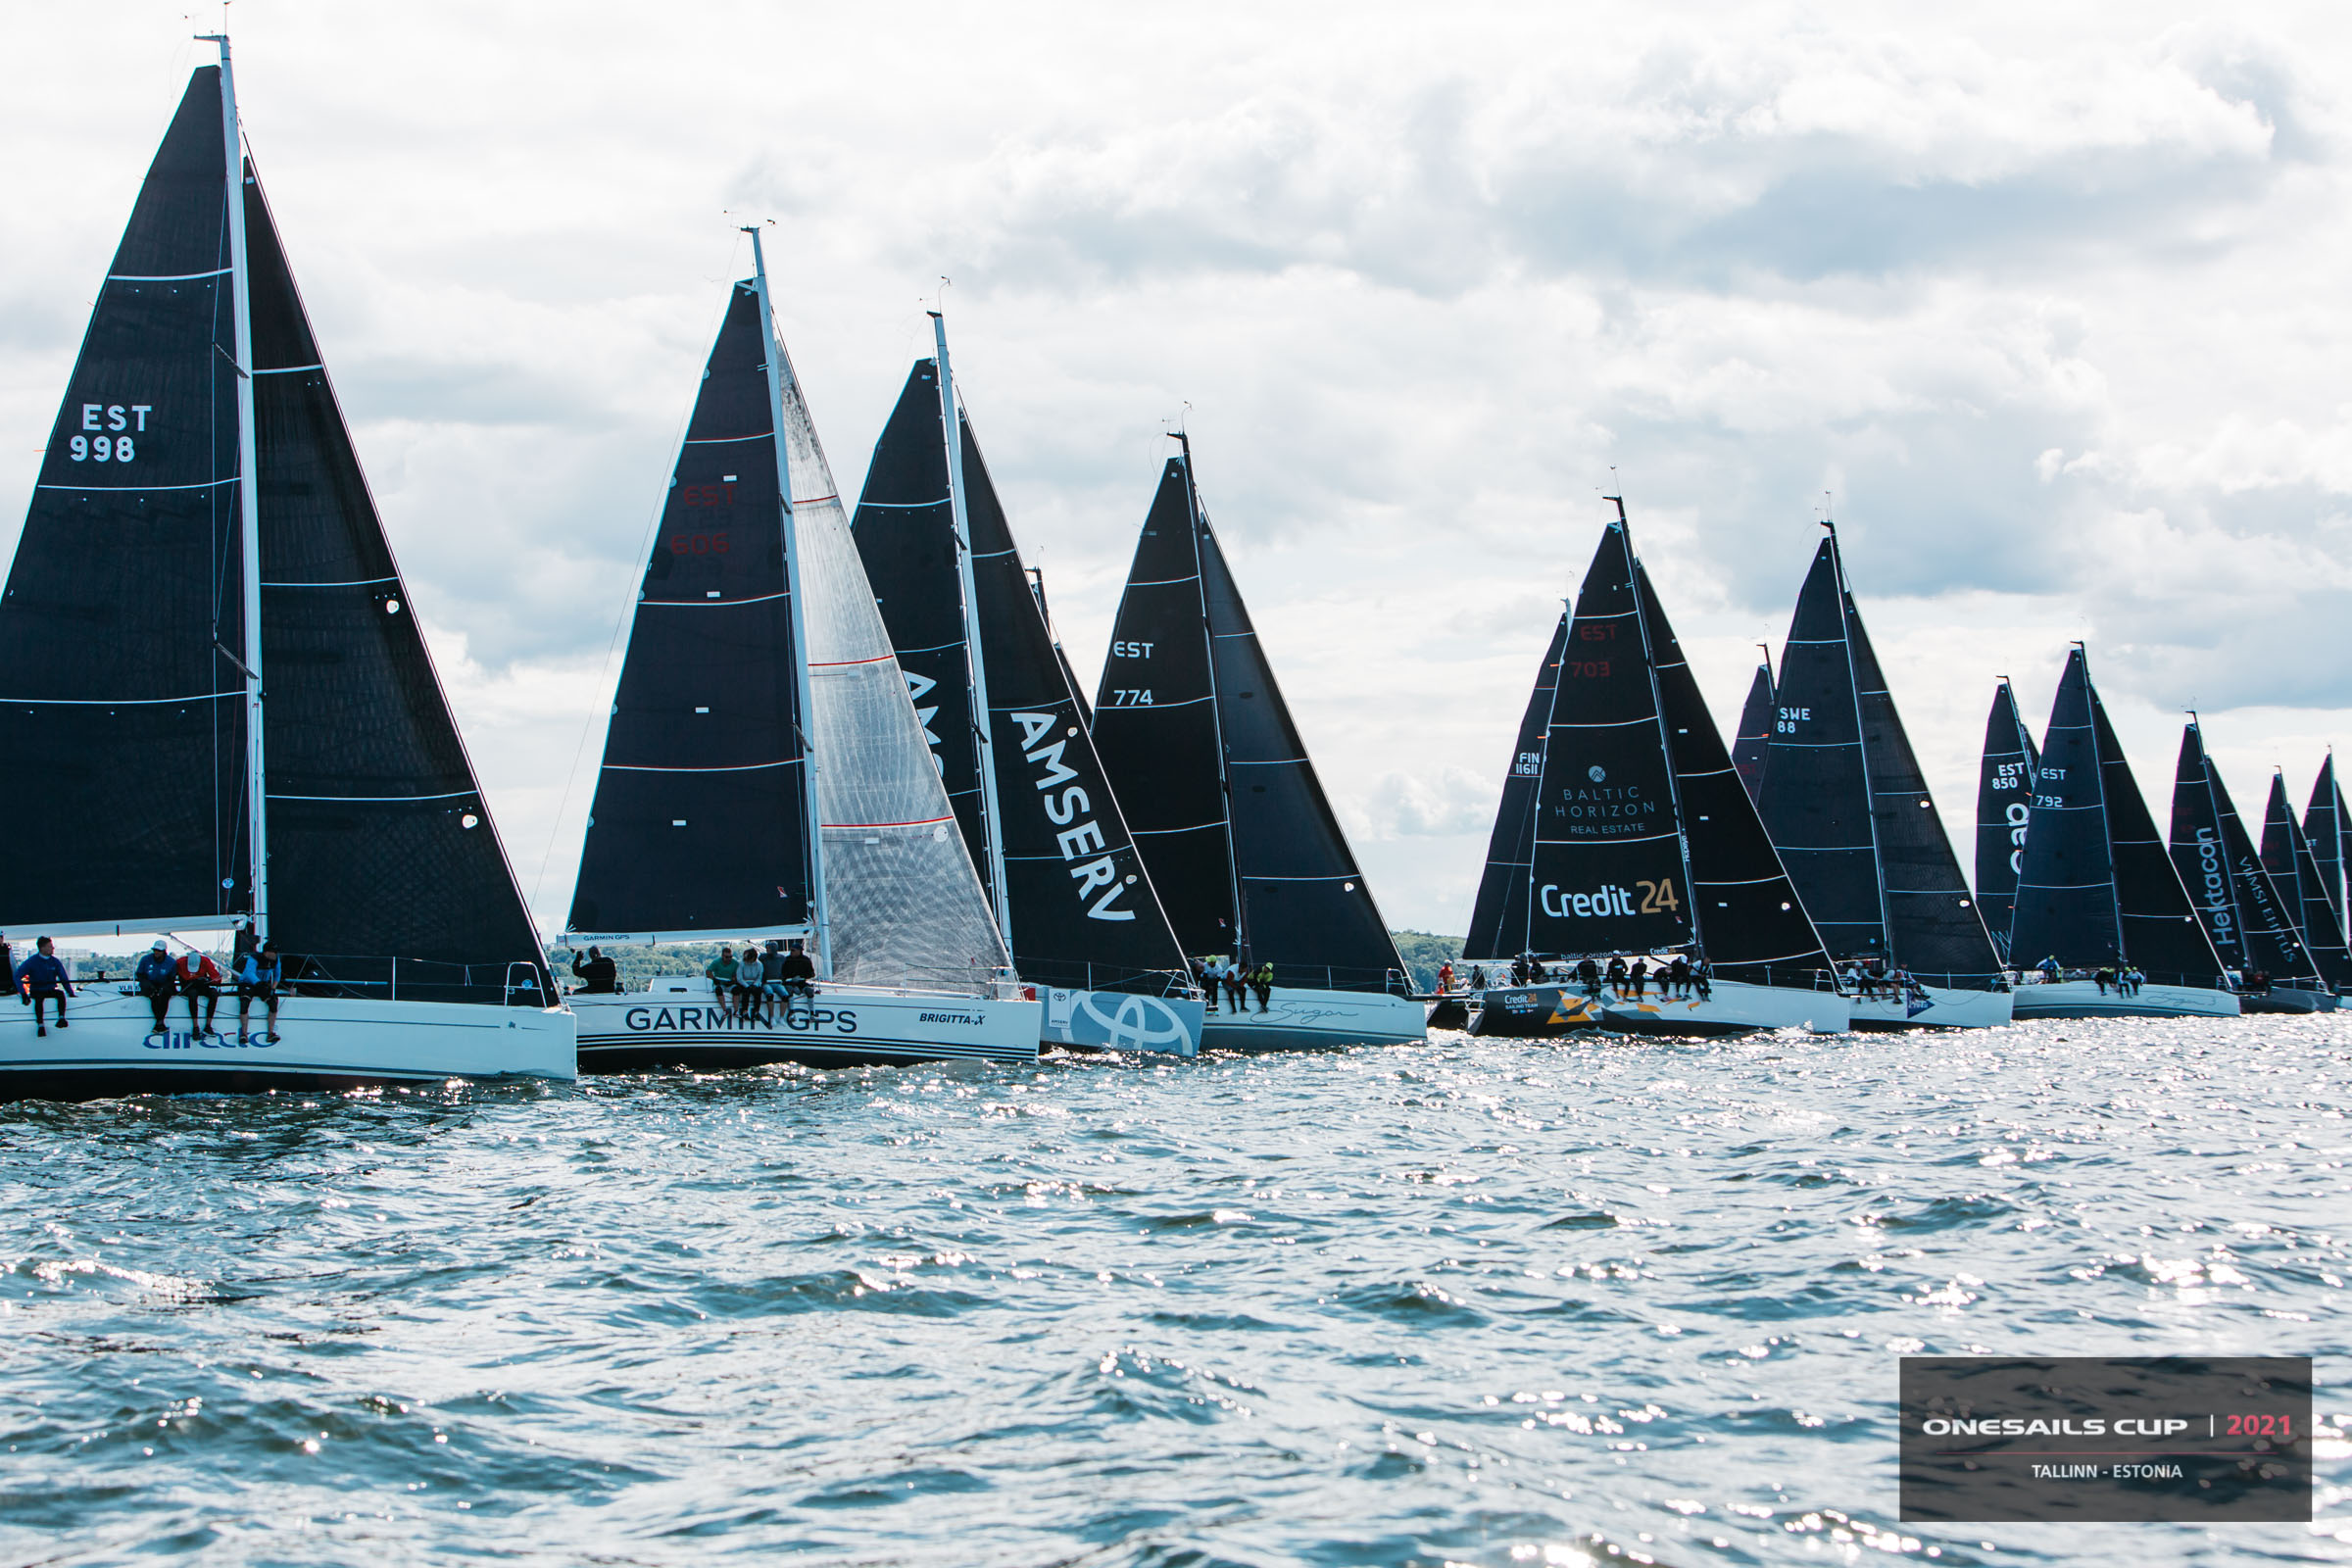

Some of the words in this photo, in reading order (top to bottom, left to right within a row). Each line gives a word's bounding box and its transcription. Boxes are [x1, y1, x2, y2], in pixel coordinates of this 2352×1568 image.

[83, 404, 152, 431] EST
[70, 435, 135, 463] 998
[683, 484, 737, 506] EST
[671, 533, 730, 555] 606
[1580, 623, 1618, 641] EST
[1113, 641, 1153, 659] EST
[1570, 662, 1611, 678] 703
[1113, 689, 1153, 706] 774
[1780, 708, 1811, 720] SWE
[1777, 720, 1796, 733] 88
[1519, 753, 1540, 763] FIN
[1998, 762, 2025, 776] EST
[2040, 767, 2066, 780] EST
[1991, 777, 2018, 790] 850
[1563, 786, 1640, 802] BALTIC
[2035, 795, 2063, 808] 792
[1010, 712, 1136, 921] AMSERV
[1555, 801, 1655, 817] HORIZON
[1570, 824, 1598, 835] REAL
[1601, 822, 1645, 834] ESTATE
[2195, 827, 2236, 945] Hektacon
[786, 1008, 858, 1033] GPS
